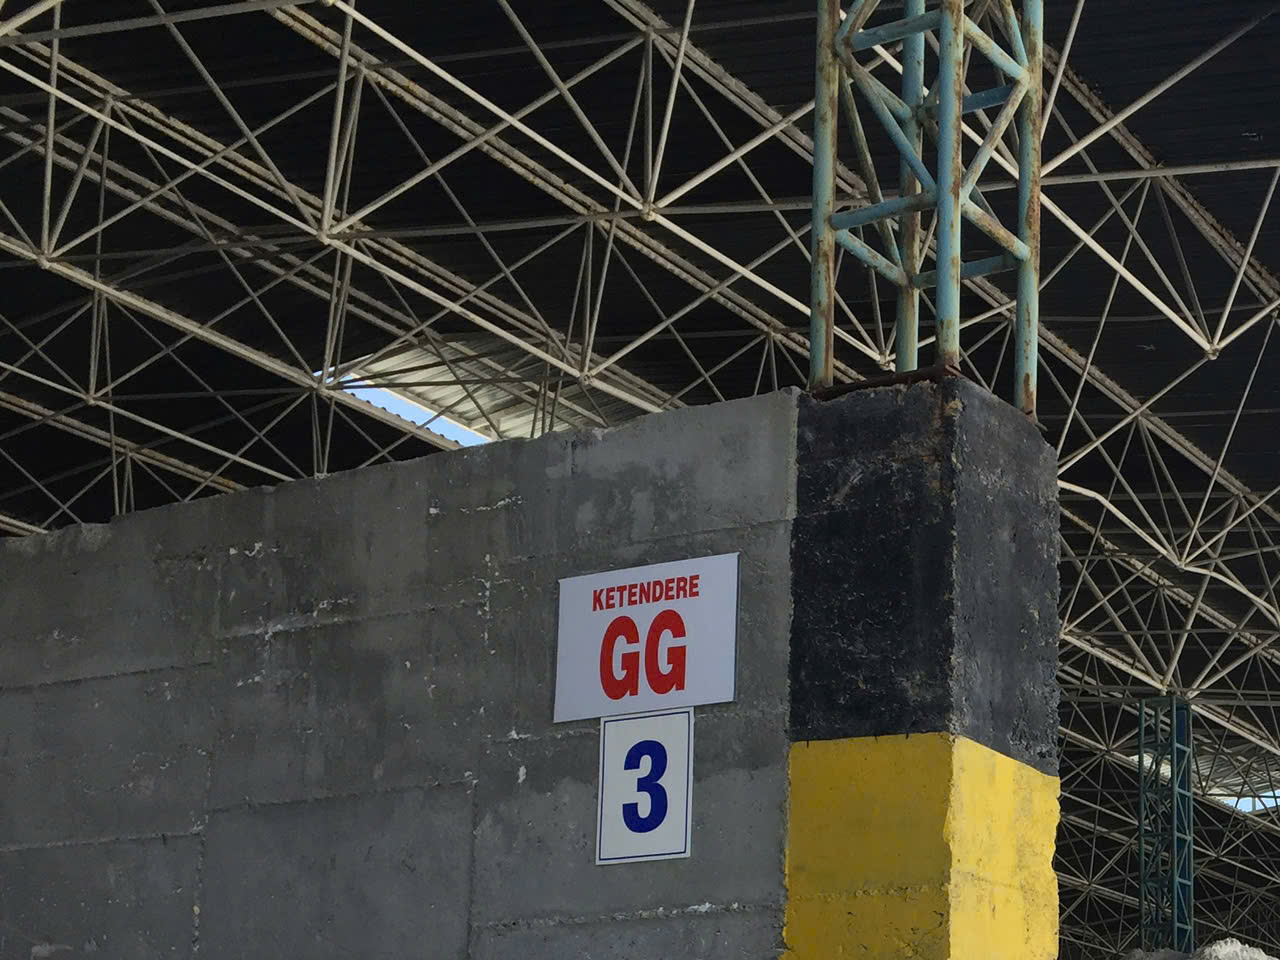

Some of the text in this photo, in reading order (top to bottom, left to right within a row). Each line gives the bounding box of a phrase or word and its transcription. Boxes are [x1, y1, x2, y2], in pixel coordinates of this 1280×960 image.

[592, 574, 700, 611] KETENDERE
[599, 609, 687, 700] GG
[622, 739, 668, 833] 3
